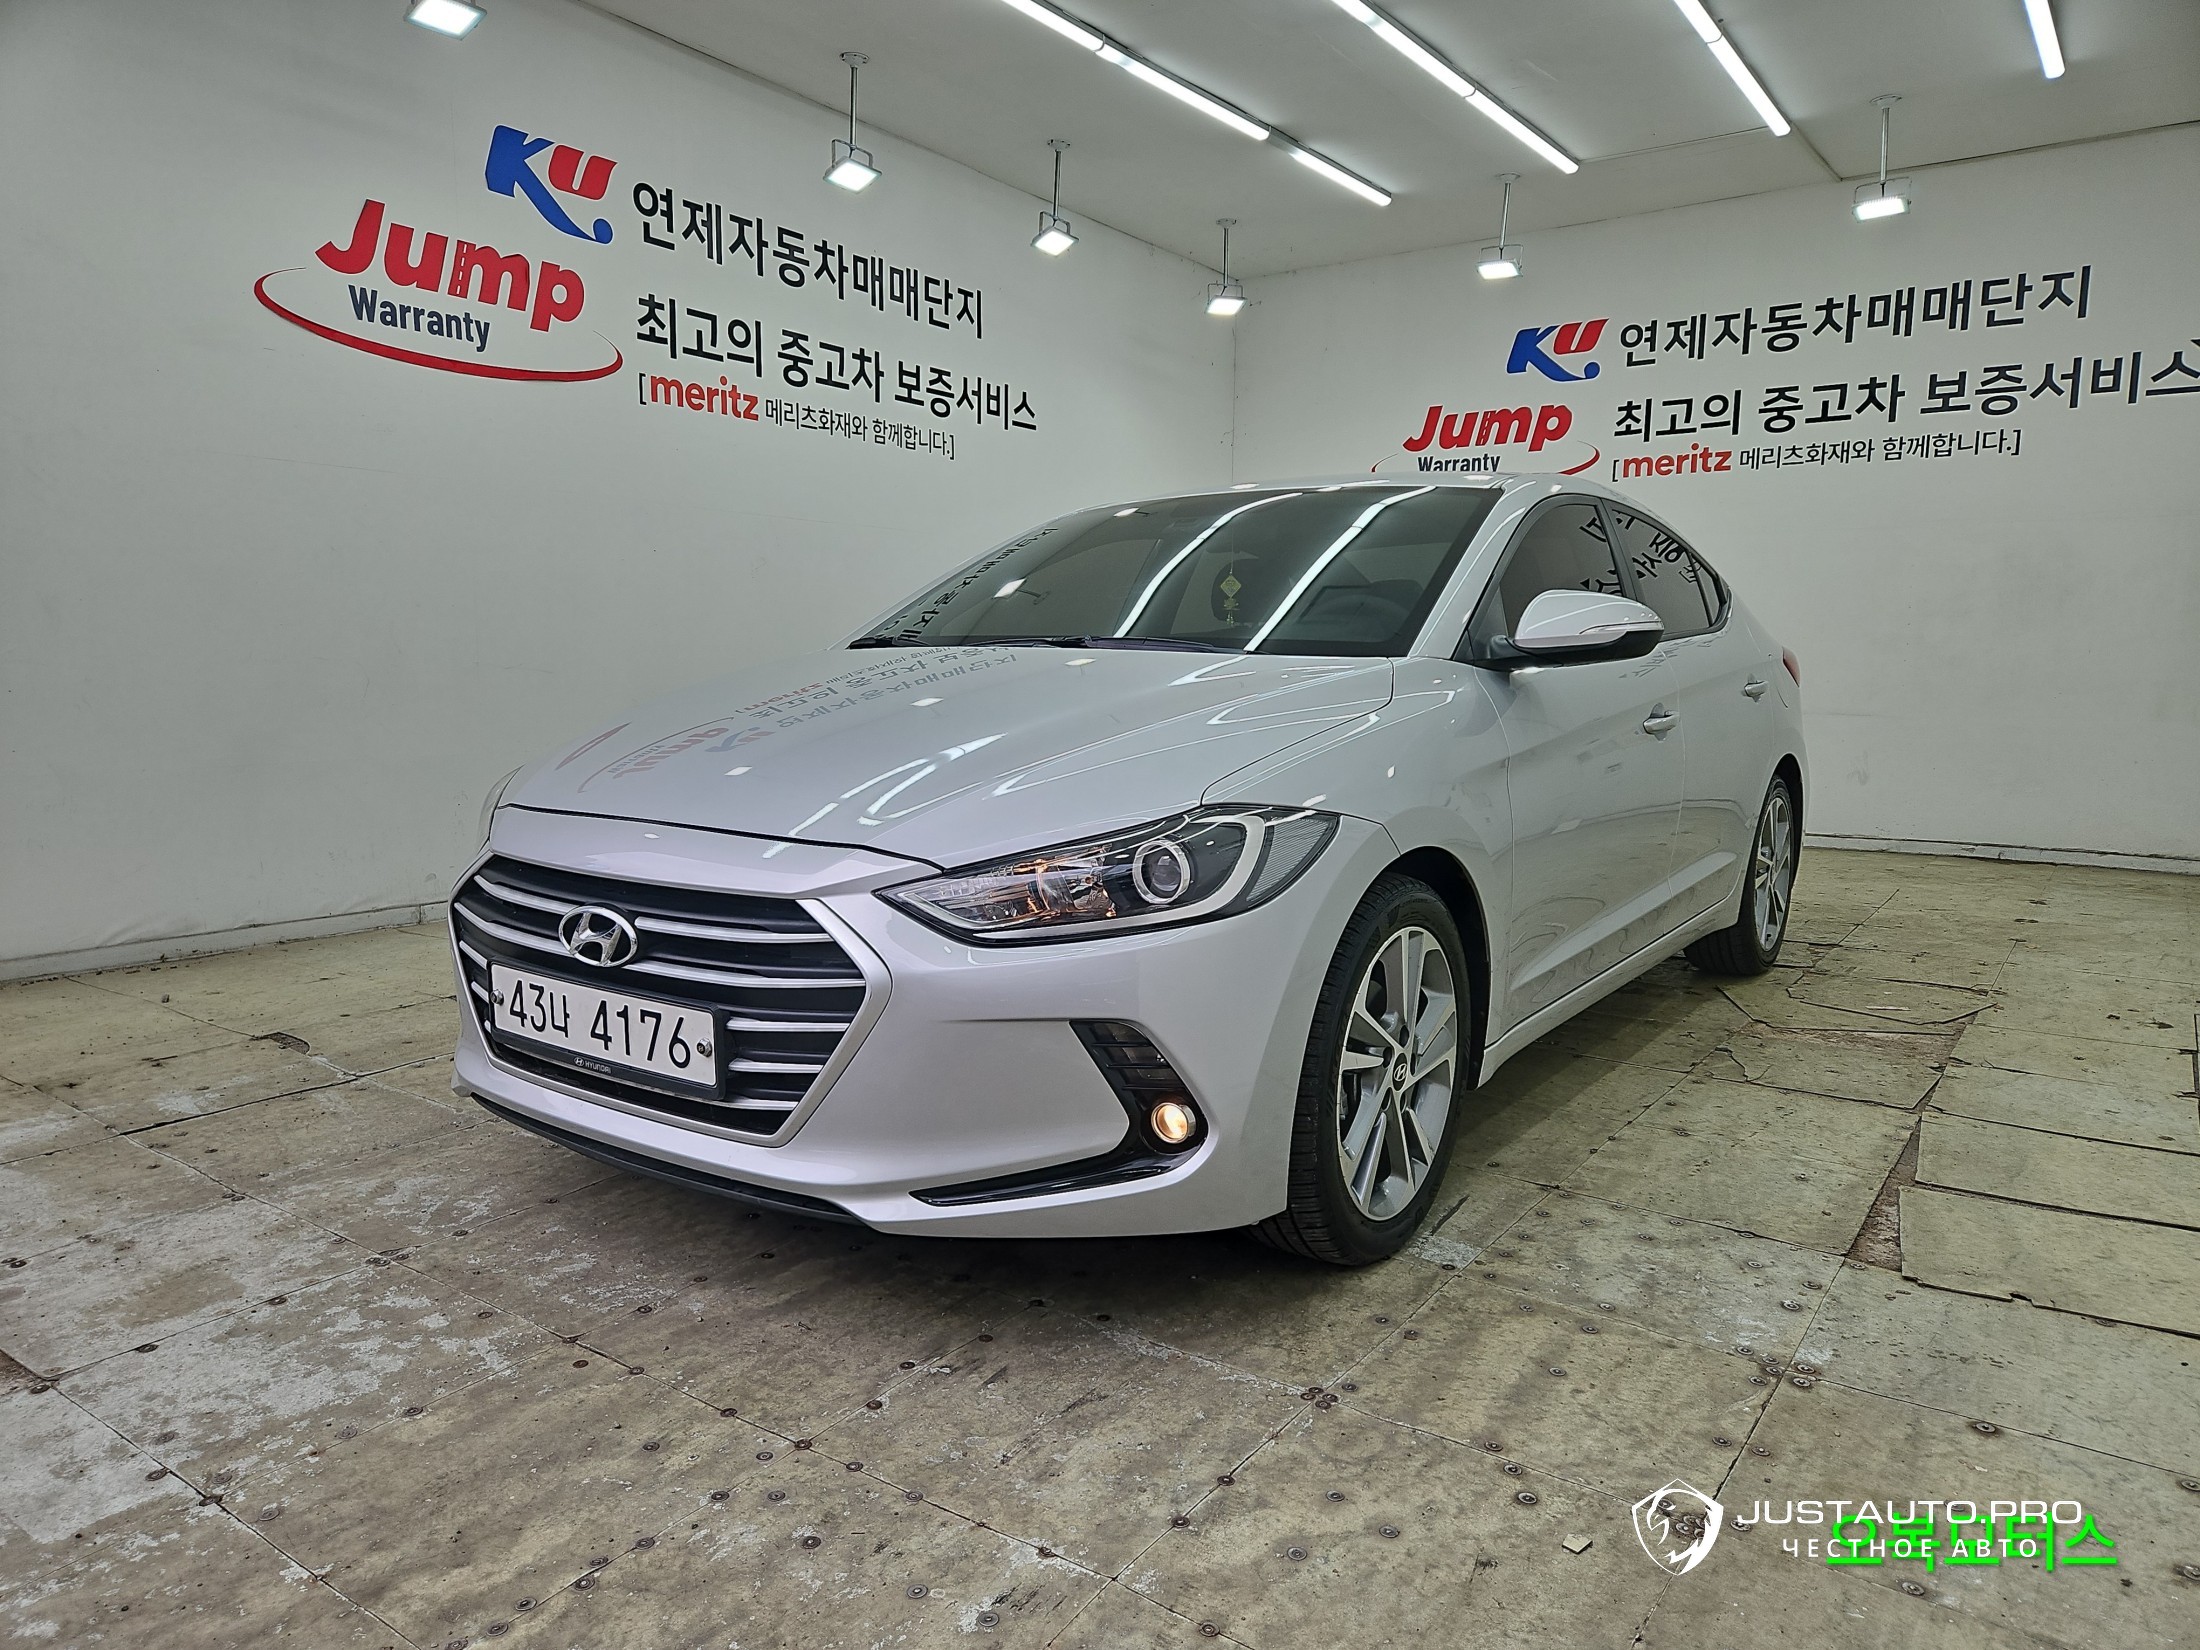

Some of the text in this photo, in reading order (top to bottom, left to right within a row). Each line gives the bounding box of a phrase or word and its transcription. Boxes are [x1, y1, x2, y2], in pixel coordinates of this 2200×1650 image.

[314, 198, 586, 333] Jump
[632, 181, 984, 340] 연제자동차매매단지
[348, 284, 491, 353] Warranty
[1619, 264, 2092, 368] 연제자동차매매단지
[636, 293, 1038, 432] 최고의 중고차 보증서비스
[1613, 350, 2200, 443] 최고의 중고차 보증서비스
[765, 398, 868, 442] 메리츠화재와
[1402, 404, 1573, 452] Jump
[1739, 438, 1876, 471] 메리츠화재와
[1417, 452, 1501, 472] Warranty
[509, 979, 691, 1069] 43나 4176
[585, 1060, 612, 1074] HYUNDAI
